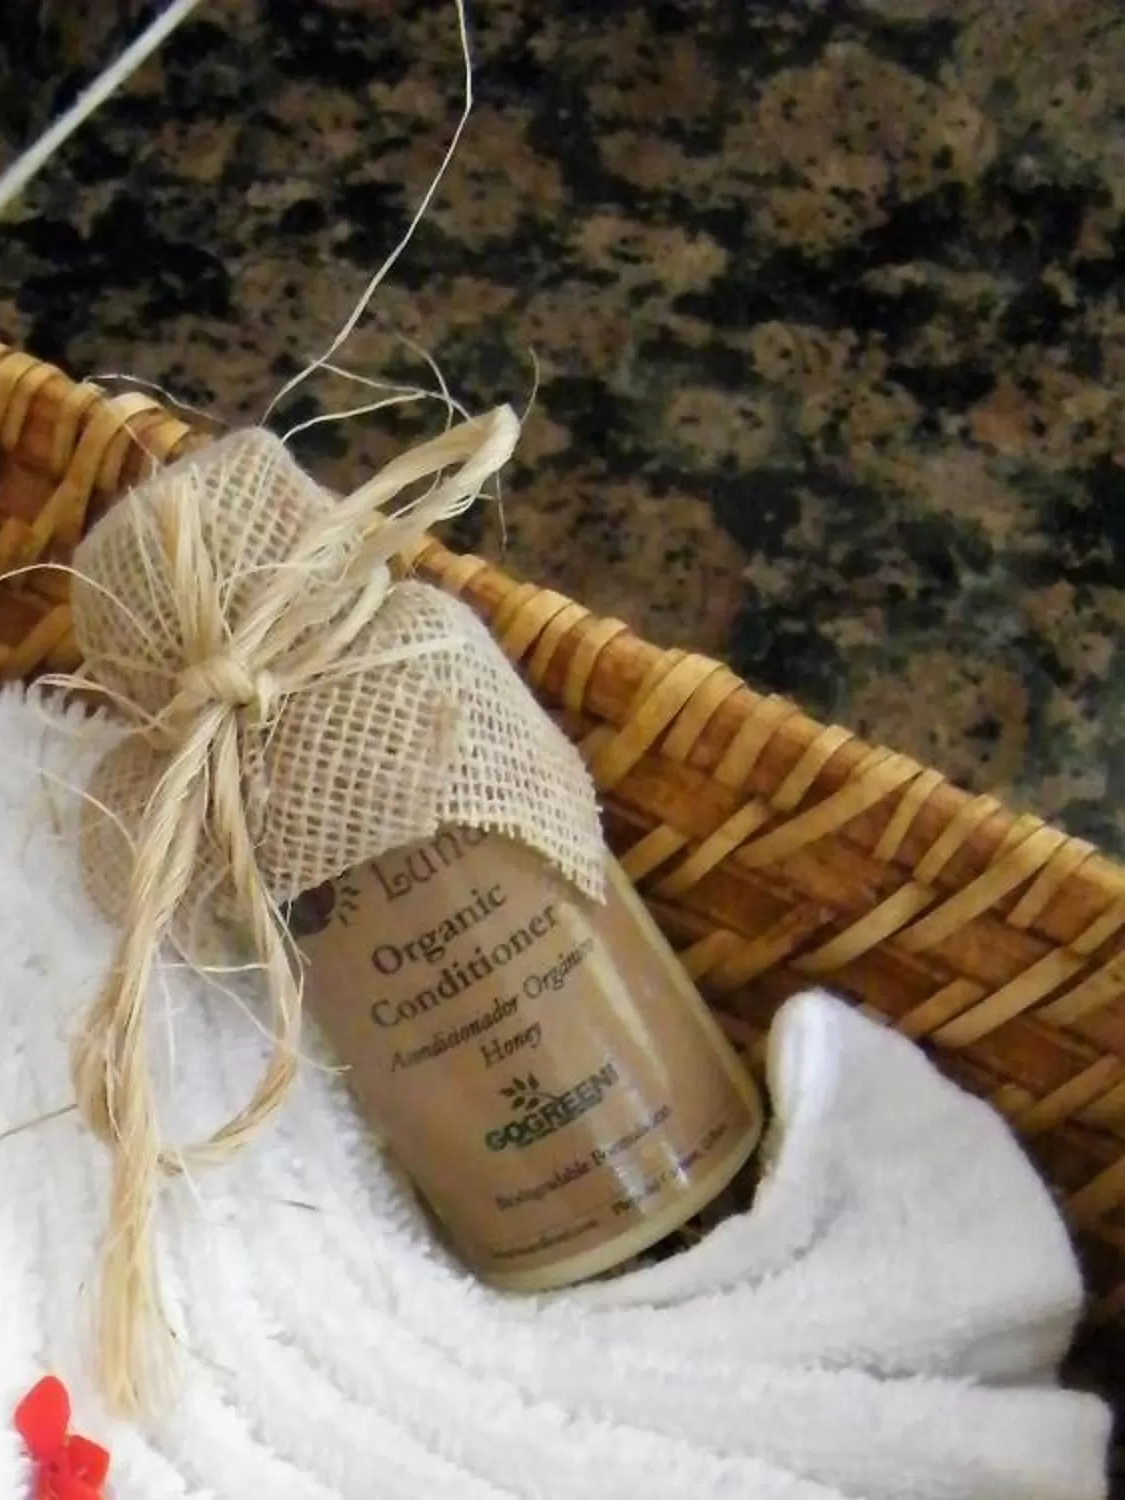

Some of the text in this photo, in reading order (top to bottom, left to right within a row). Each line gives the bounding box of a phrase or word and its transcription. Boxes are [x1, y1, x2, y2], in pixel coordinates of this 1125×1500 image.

[371, 883, 508, 976] Organic
[371, 903, 559, 1027] Conditioner
[479, 1021, 544, 1070] Honey
